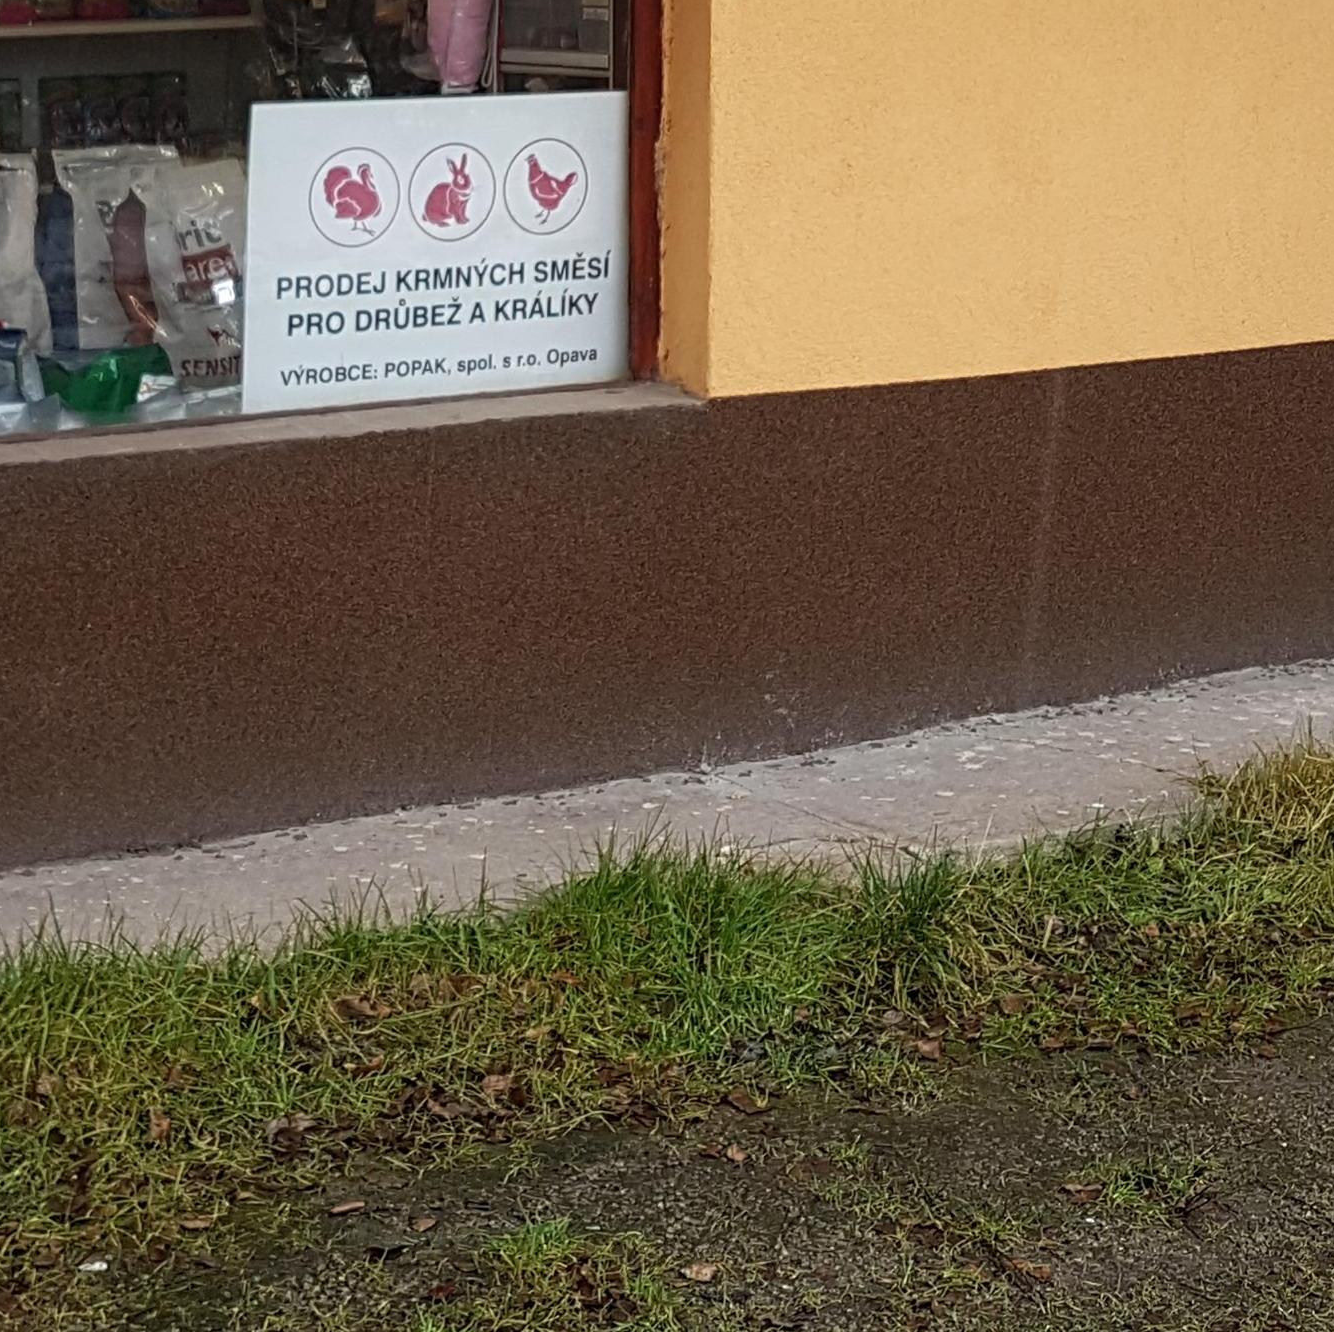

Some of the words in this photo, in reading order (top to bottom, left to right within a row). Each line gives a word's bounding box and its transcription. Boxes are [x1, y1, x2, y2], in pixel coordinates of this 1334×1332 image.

[174, 219, 223, 250] rit
[184, 257, 226, 283] are
[276, 271, 386, 300] PRODEJ
[396, 258, 525, 293] KRMNÝCH
[533, 250, 611, 283] SMĚSÍ
[287, 311, 345, 337] PRO
[355, 296, 462, 332] DRŮBEŽ
[469, 301, 486, 324] A
[495, 288, 599, 322] KRÁLÍKY
[280, 364, 377, 386] VÝROBCE:
[384, 358, 451, 378] POPAK,
[457, 354, 496, 375] spol.
[503, 355, 511, 368] s
[517, 354, 541, 368] r.o.
[547, 348, 597, 367] Opava
